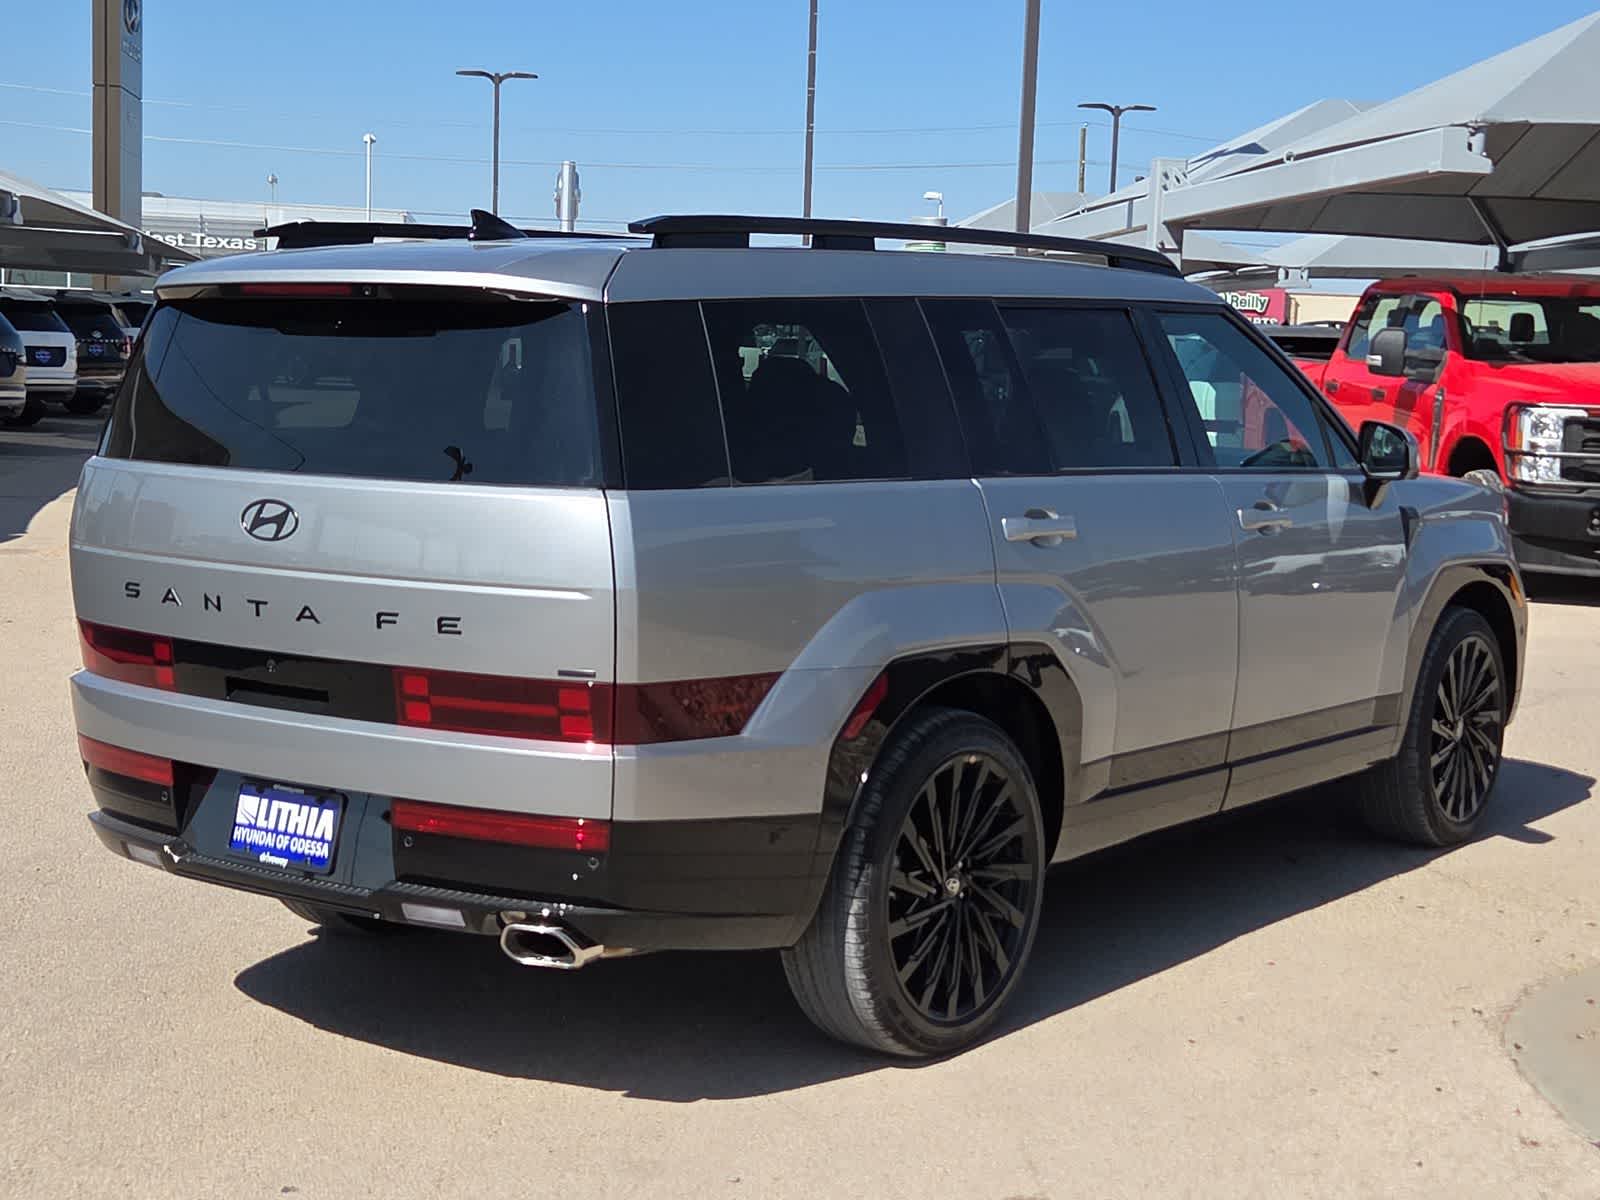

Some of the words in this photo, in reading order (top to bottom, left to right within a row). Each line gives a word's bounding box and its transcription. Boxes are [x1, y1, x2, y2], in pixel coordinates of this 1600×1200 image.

[191, 232, 257, 250] Texas
[124, 581, 321, 625] SANTA
[375, 611, 463, 636] FE
[256, 798, 334, 841] LITHIA
[233, 826, 276, 849] HYUNDAI
[276, 834, 290, 850] OF
[290, 837, 329, 859] ODESSA
